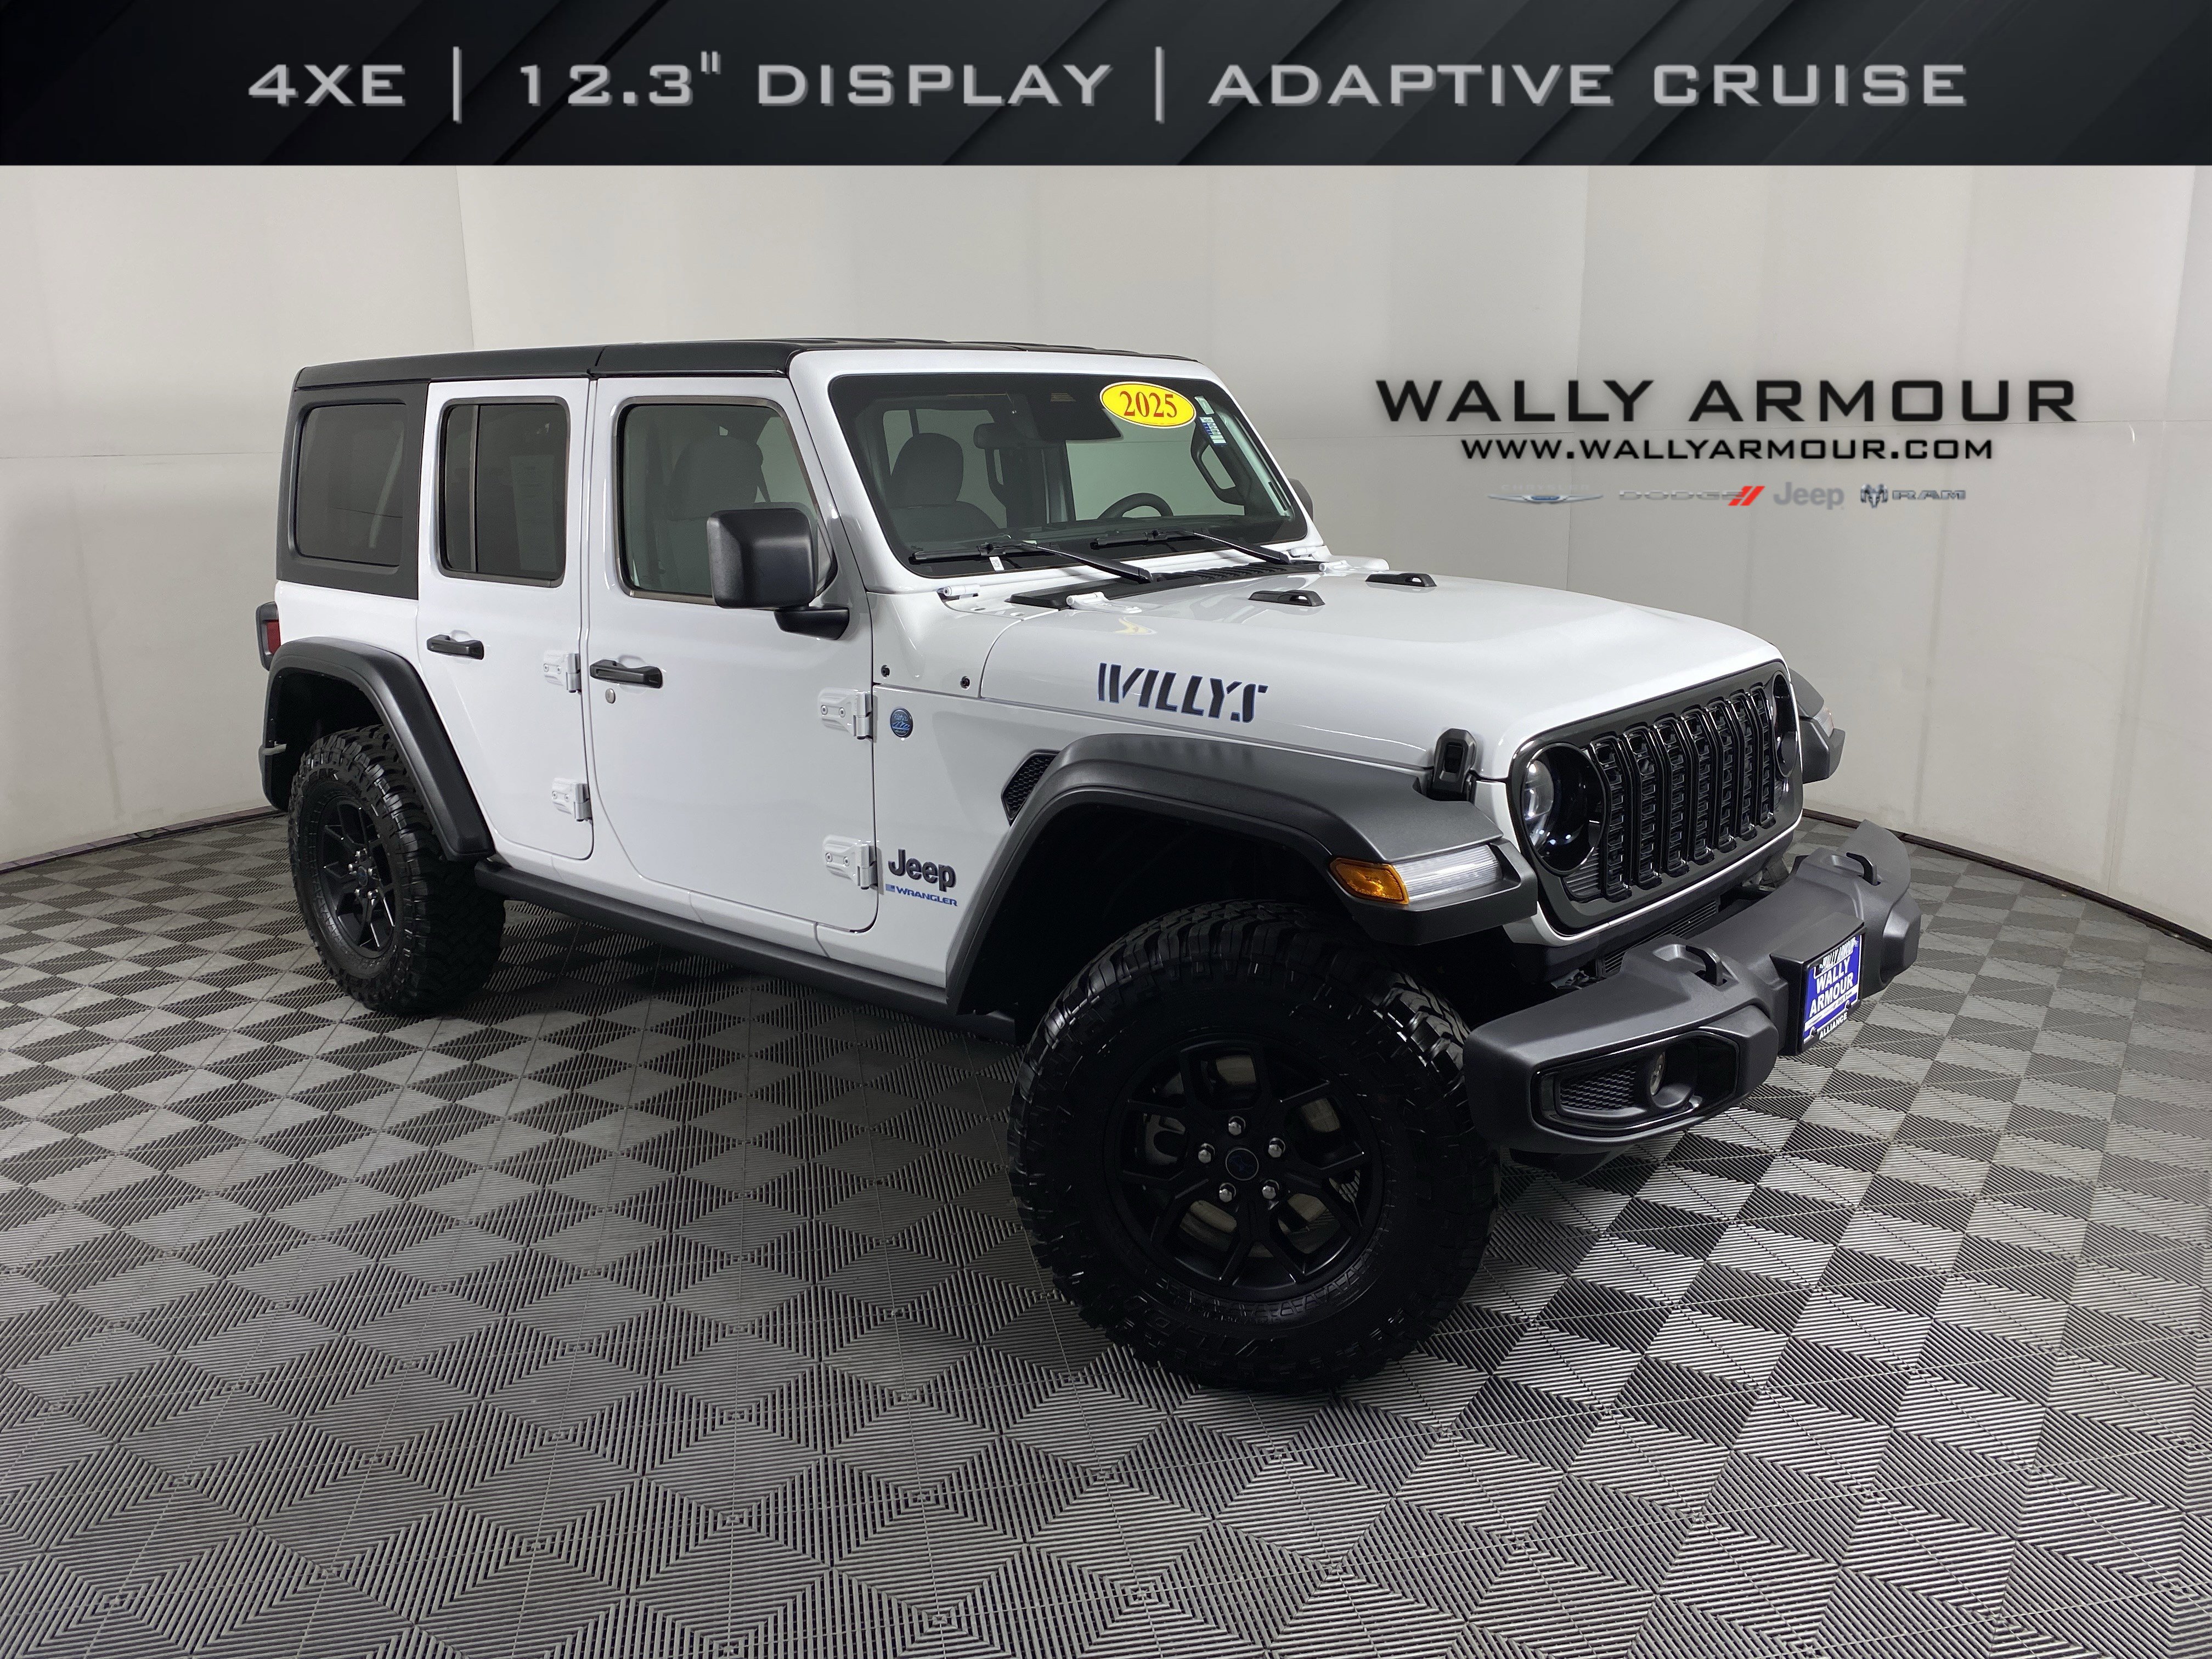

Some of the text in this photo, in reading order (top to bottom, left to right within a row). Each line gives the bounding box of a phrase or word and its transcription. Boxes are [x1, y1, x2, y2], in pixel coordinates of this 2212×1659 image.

[1119, 391, 1177, 417] 2025
[1097, 662, 1268, 723] WILLYS
[888, 849, 956, 892] Jeep
[896, 886, 957, 906] WRANGLER
[1816, 956, 1851, 994] WALLY
[1809, 972, 1854, 1018] ARMOUR
[1819, 1012, 1848, 1040] ALLIANCE
